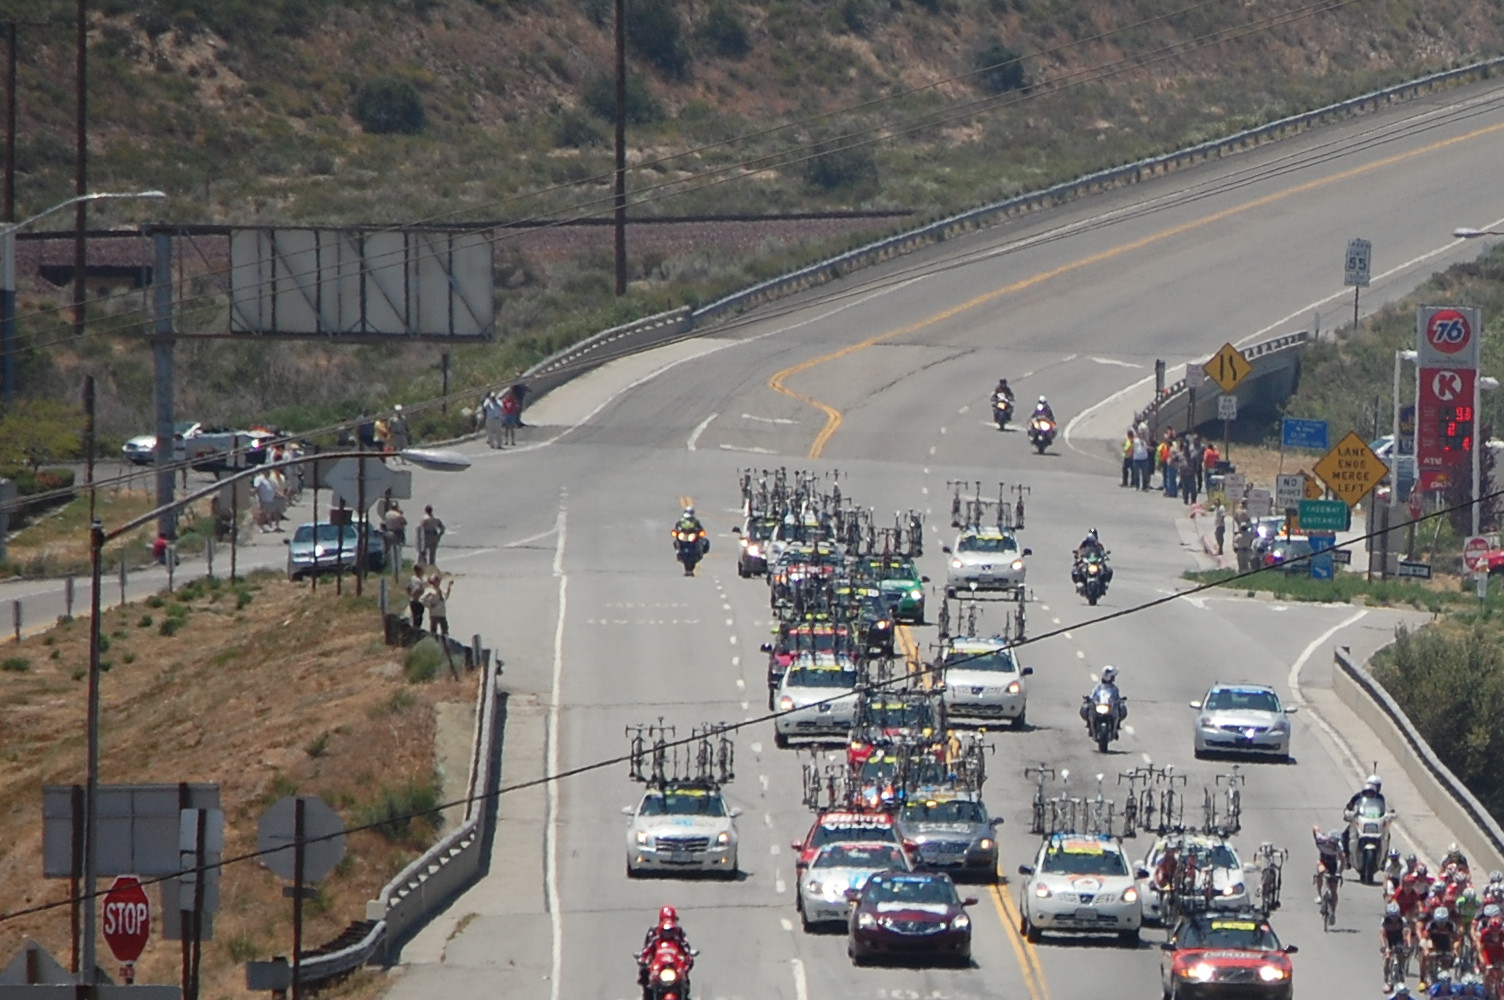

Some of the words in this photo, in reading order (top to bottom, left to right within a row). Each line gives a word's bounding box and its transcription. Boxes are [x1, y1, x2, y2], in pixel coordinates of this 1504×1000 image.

[1348, 257, 1367, 270] 55
[1433, 318, 1465, 343] 76
[1438, 373, 1460, 399] K
[1337, 448, 1365, 457] LANE
[1337, 459, 1366, 468] ENDS
[1332, 471, 1370, 481] MERGE
[1283, 478, 1297, 486] NO
[1337, 483, 1364, 493] LEFT
[105, 902, 147, 935] STOP
